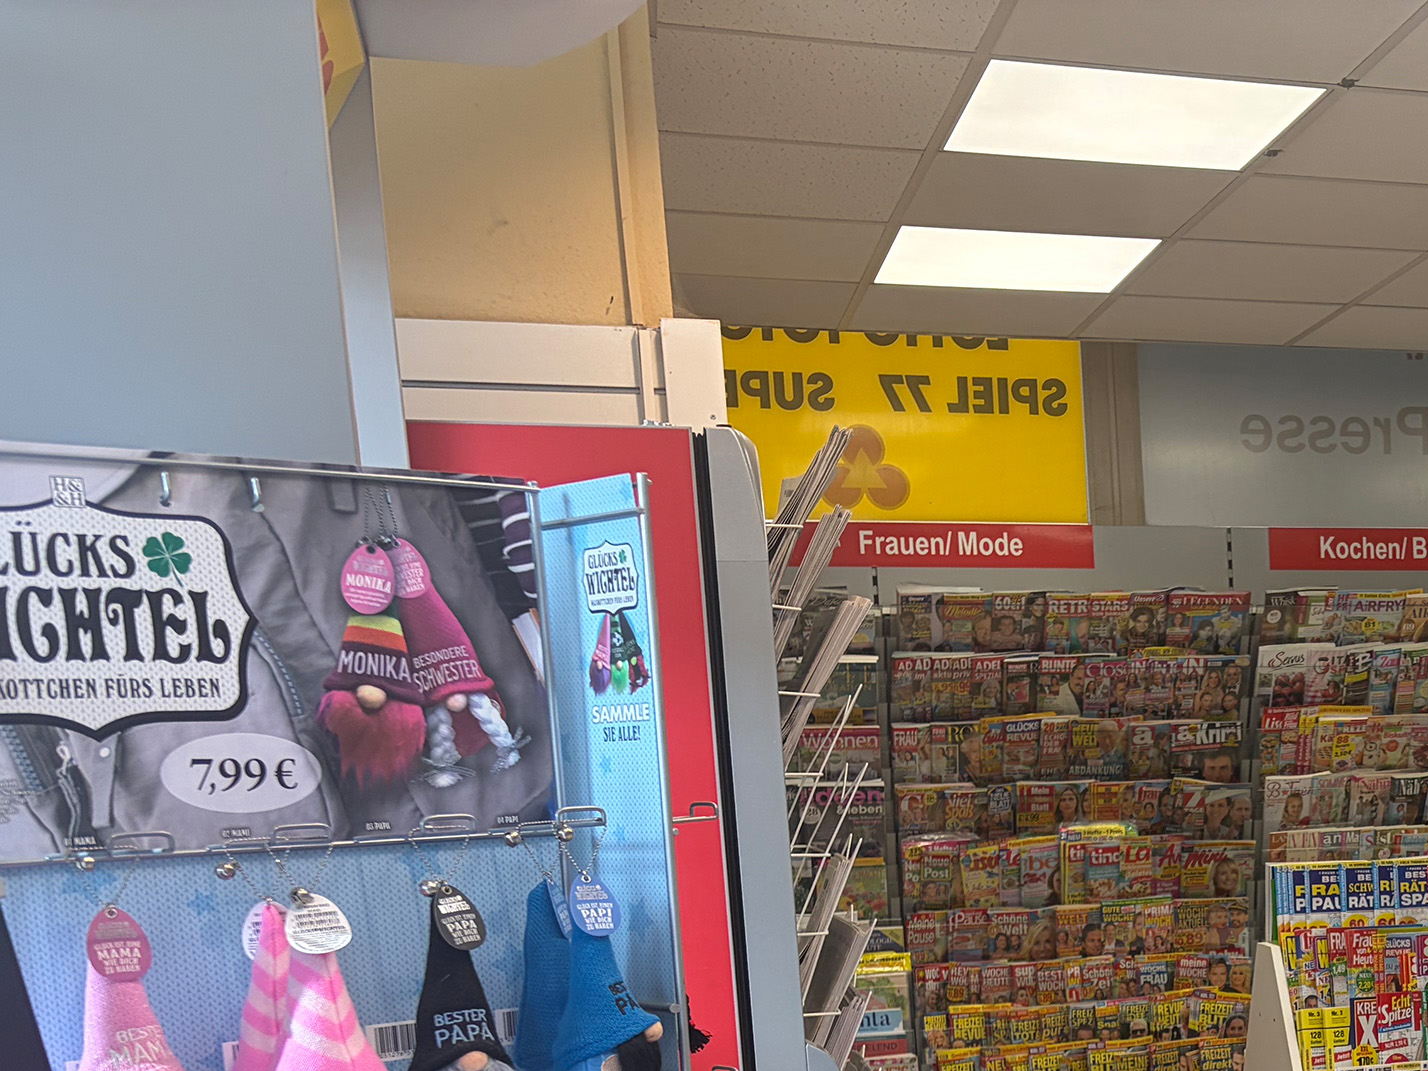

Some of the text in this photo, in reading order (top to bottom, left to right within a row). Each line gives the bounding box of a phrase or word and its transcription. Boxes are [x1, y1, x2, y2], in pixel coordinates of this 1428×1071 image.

[859, 530, 1023, 557] Frauen/ Mode
[1319, 537, 1407, 561] Kochen/
[588, 550, 618, 569] GLÜCKS
[346, 573, 392, 593] MONIKA
[586, 567, 635, 595] WICHTEL
[0, 585, 231, 665] ICHTEL
[337, 650, 412, 683] MONIKA
[412, 645, 468, 668] BESONDERE
[106, 674, 152, 699] FÜRS
[161, 678, 221, 698] LEBEN
[412, 660, 481, 693] SCHWESTER
[592, 704, 649, 723] SAMMLE
[604, 726, 640, 742] SIE ALLE!
[190, 758, 297, 797] 7,99 €
[581, 909, 613, 918] PAPI
[447, 920, 476, 932] PAPA
[97, 948, 141, 960] MAMA
[1391, 994, 1411, 1007] Echt
[433, 1009, 486, 1027] BESTER
[434, 1022, 494, 1048] PAPA
